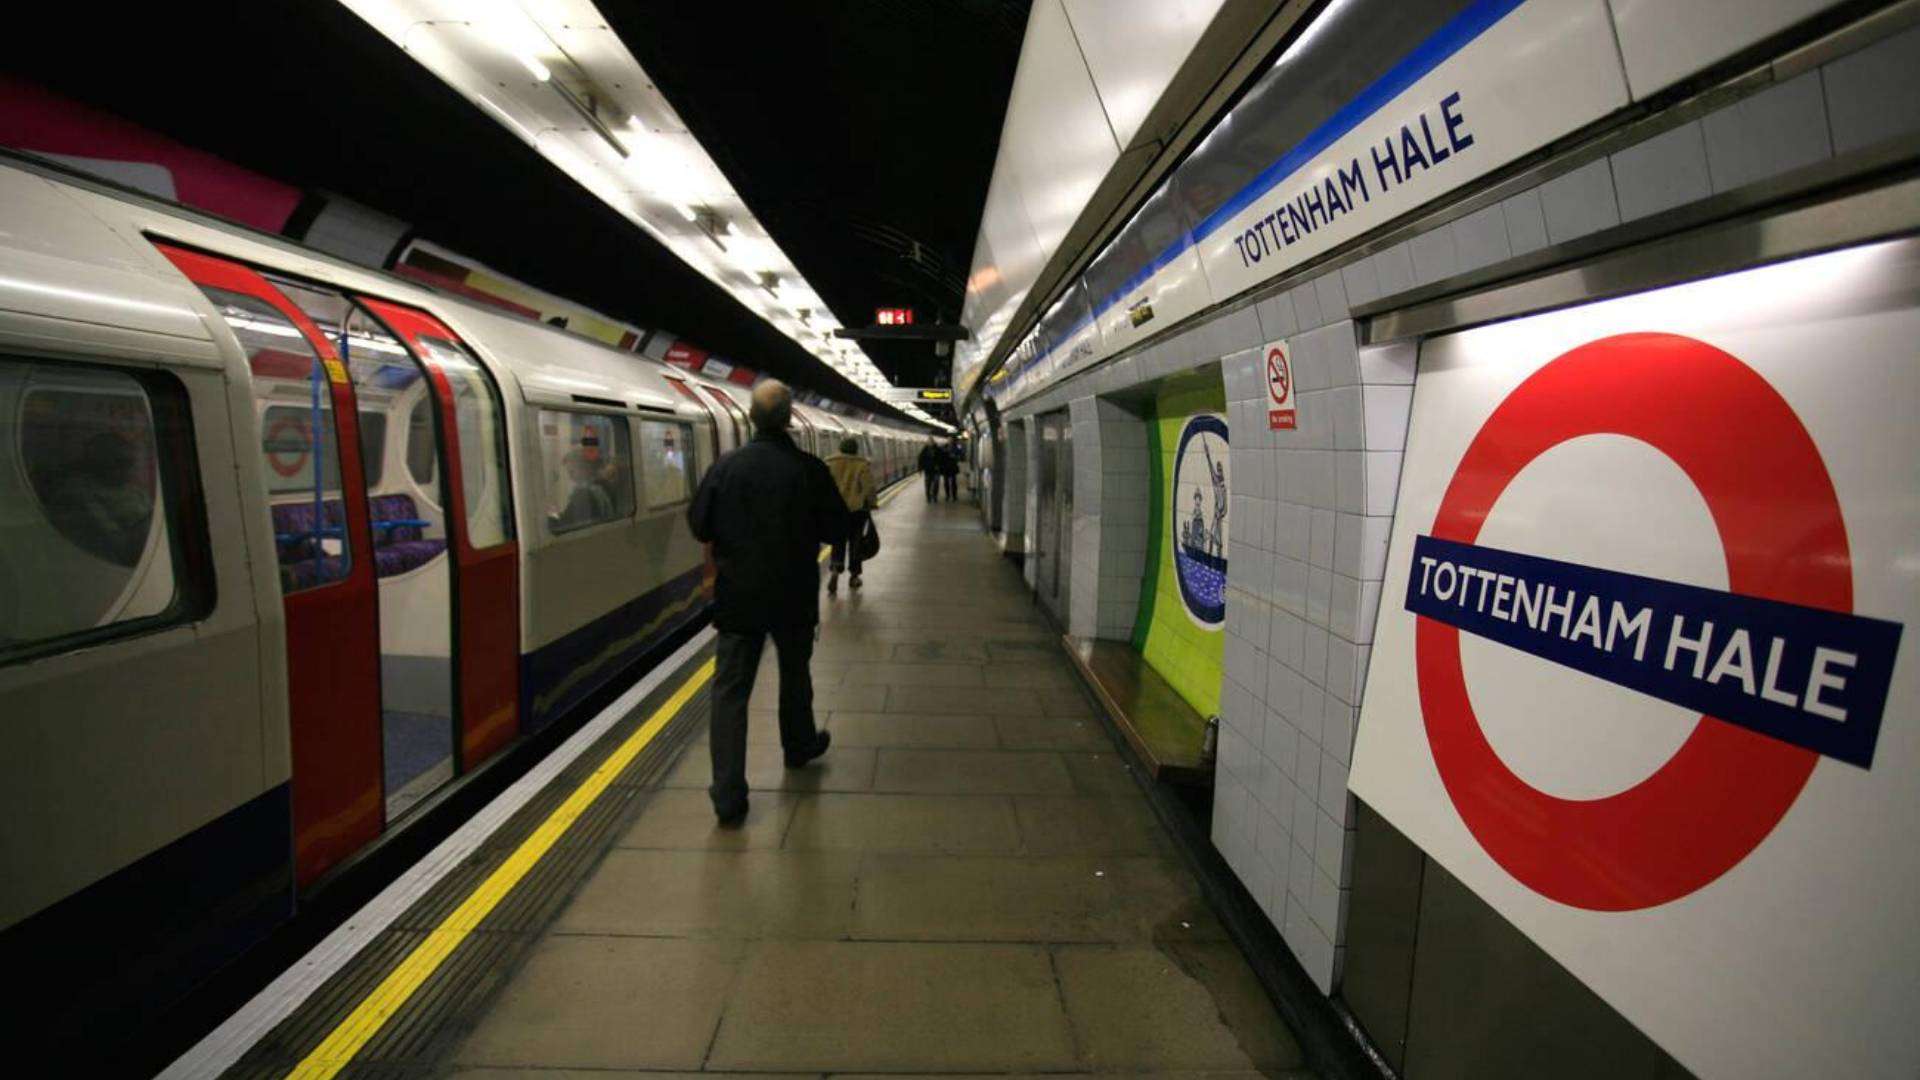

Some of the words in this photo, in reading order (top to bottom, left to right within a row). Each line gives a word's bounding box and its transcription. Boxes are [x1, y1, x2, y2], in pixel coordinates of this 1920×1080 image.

[1234, 158, 1369, 267] TOTTENHAM
[1371, 91, 1474, 192] HALE
[1420, 556, 1652, 661] TOTTENHAM
[1664, 615, 1857, 722] HALE
